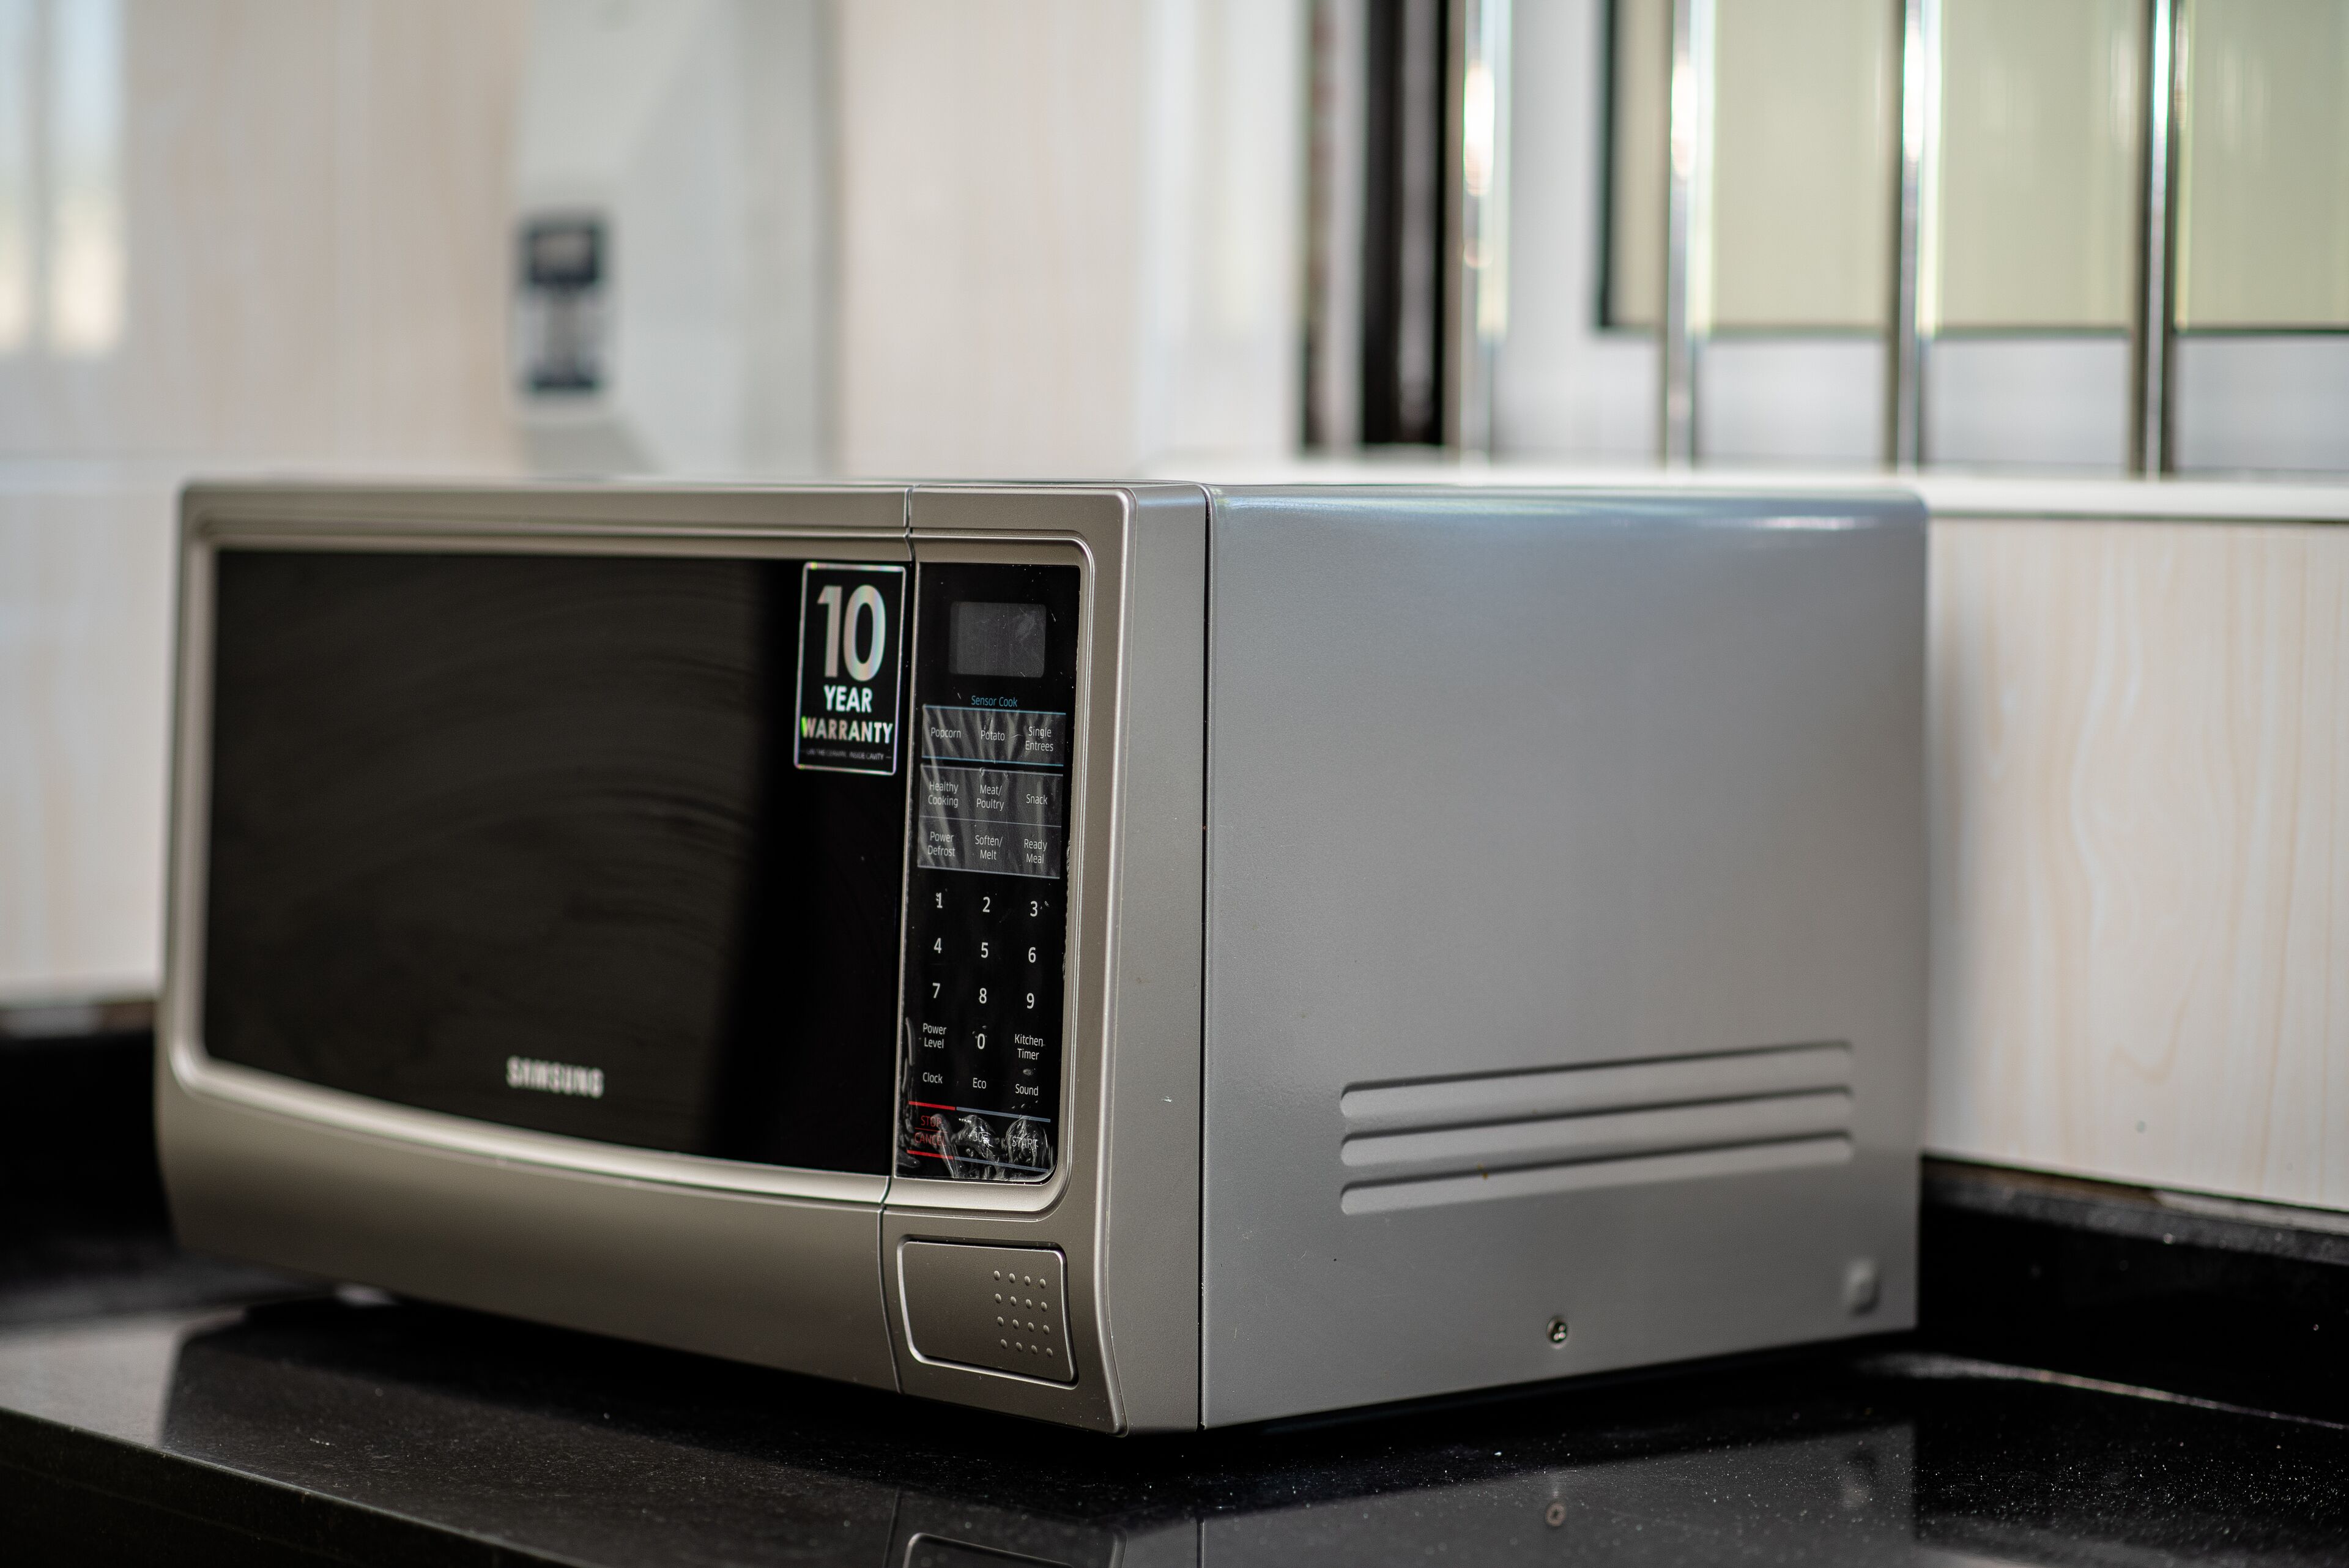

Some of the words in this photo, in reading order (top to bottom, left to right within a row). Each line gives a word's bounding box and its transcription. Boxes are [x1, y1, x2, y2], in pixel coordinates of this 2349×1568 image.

[817, 585, 886, 682] 10
[823, 685, 873, 713] YEAR
[971, 696, 996, 706] Sensor
[999, 697, 1018, 707] Cook
[801, 716, 893, 744] WARRANTY
[930, 727, 961, 739] Popcorn
[981, 730, 1005, 741] Potato
[1028, 726, 1052, 739] Single
[1025, 740, 1053, 752] Entrees
[929, 781, 959, 794] Healthy
[979, 784, 1002, 797] Meat/
[928, 795, 958, 808] Cooking
[976, 798, 1004, 811] Poultry
[1026, 794, 1048, 805] Snack
[930, 831, 954, 842] Power
[974, 834, 1003, 847] Soften/
[927, 845, 956, 856] Defrost
[1024, 838, 1047, 852] Ready
[980, 849, 996, 860] Melt
[1026, 853, 1044, 864] Meal
[936, 892, 943, 908] 1
[982, 896, 990, 913] 2
[1030, 901, 1038, 917] 3
[933, 937, 942, 954] 4
[981, 942, 989, 958] 5
[1028, 946, 1036, 963] 6
[932, 982, 941, 998] 7
[979, 987, 987, 1004] 8
[1026, 993, 1034, 1009] 9
[922, 1023, 947, 1035] Power
[924, 1038, 944, 1049] Level
[977, 1033, 985, 1049] 0
[1014, 1034, 1043, 1047] Kitchen
[1017, 1048, 1039, 1060] Timer
[506, 1056, 604, 1098] SAMSUNG
[922, 1072, 943, 1083] Clock
[973, 1077, 987, 1089] Eco
[1015, 1083, 1039, 1096] Sound
[921, 1115, 941, 1128] STOP
[915, 1132, 946, 1146] CANCEL
[1012, 1136, 1039, 1149] START
